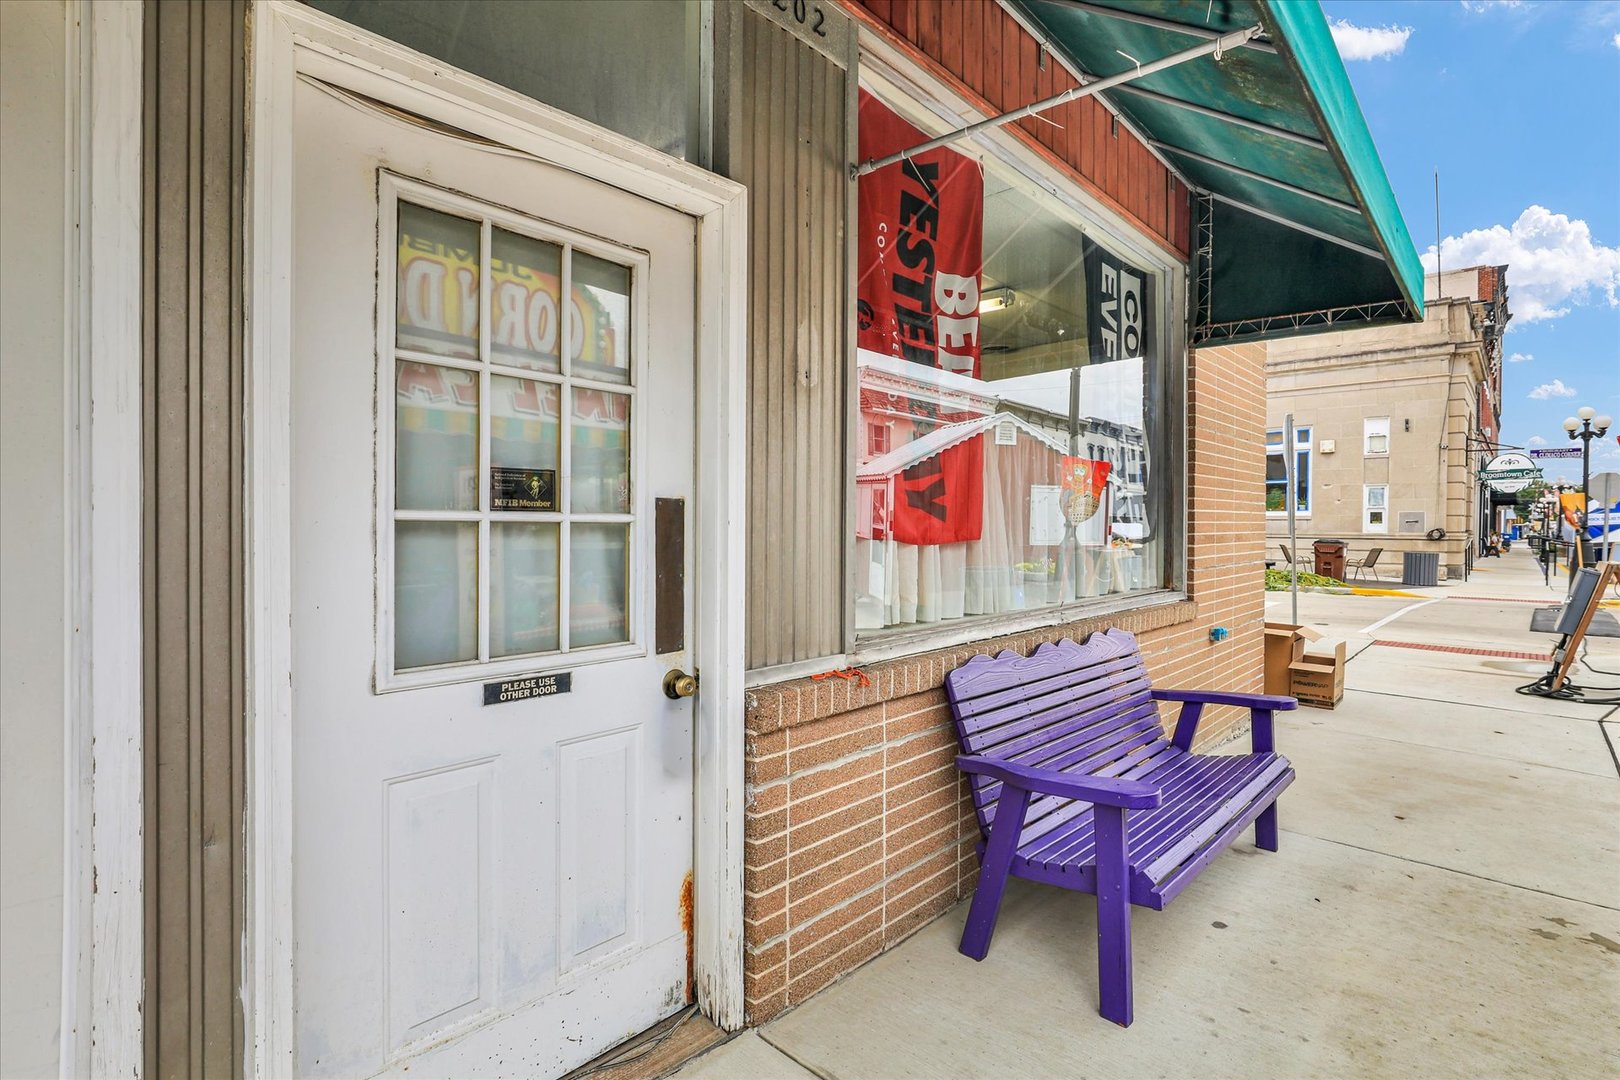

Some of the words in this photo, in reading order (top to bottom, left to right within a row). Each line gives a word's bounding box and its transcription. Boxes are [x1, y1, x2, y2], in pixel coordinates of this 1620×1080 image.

[1480, 471, 1523, 479] Broomtown
[501, 680, 536, 692] PLEASE
[539, 677, 556, 686] USE
[500, 690, 530, 701] OTHER
[532, 685, 557, 696] DOOR
